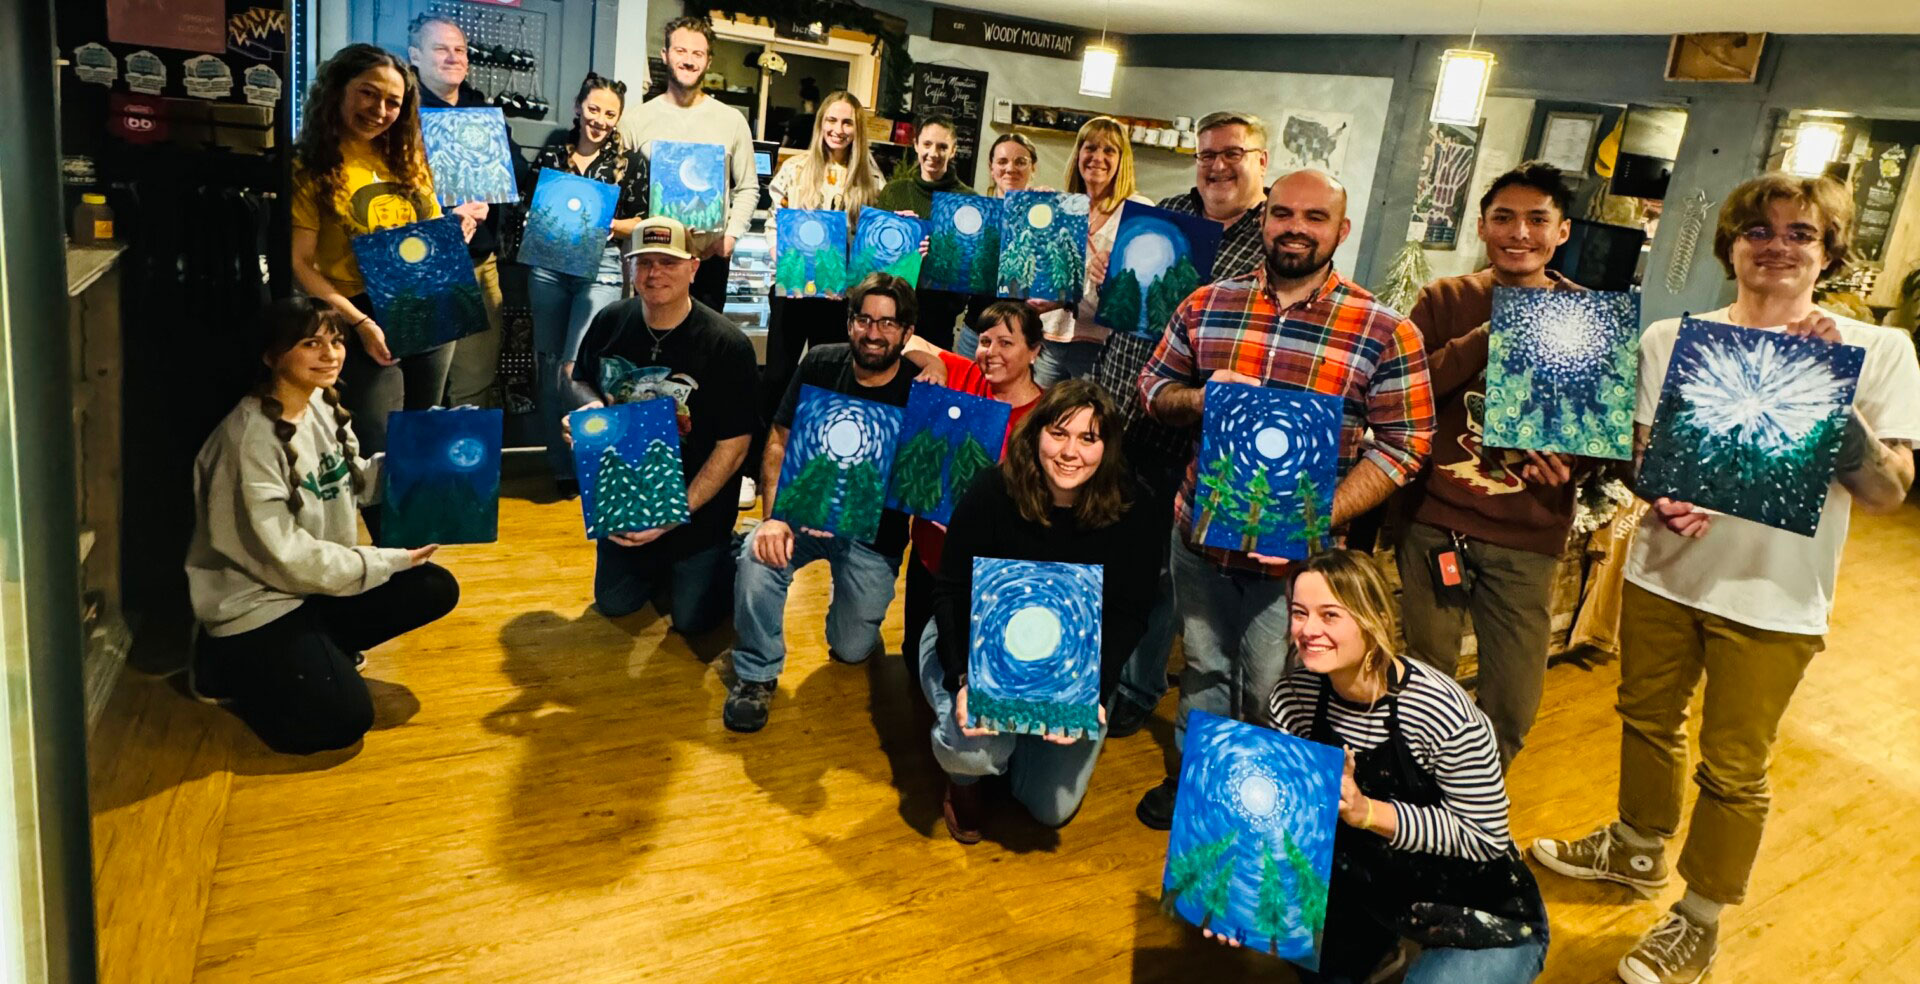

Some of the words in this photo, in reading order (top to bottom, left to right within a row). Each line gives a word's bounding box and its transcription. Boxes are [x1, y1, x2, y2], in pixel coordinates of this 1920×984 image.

[983, 22, 1021, 44] WOODY
[1021, 30, 1074, 53] MOUNTAIN
[925, 86, 948, 104] Coffee
